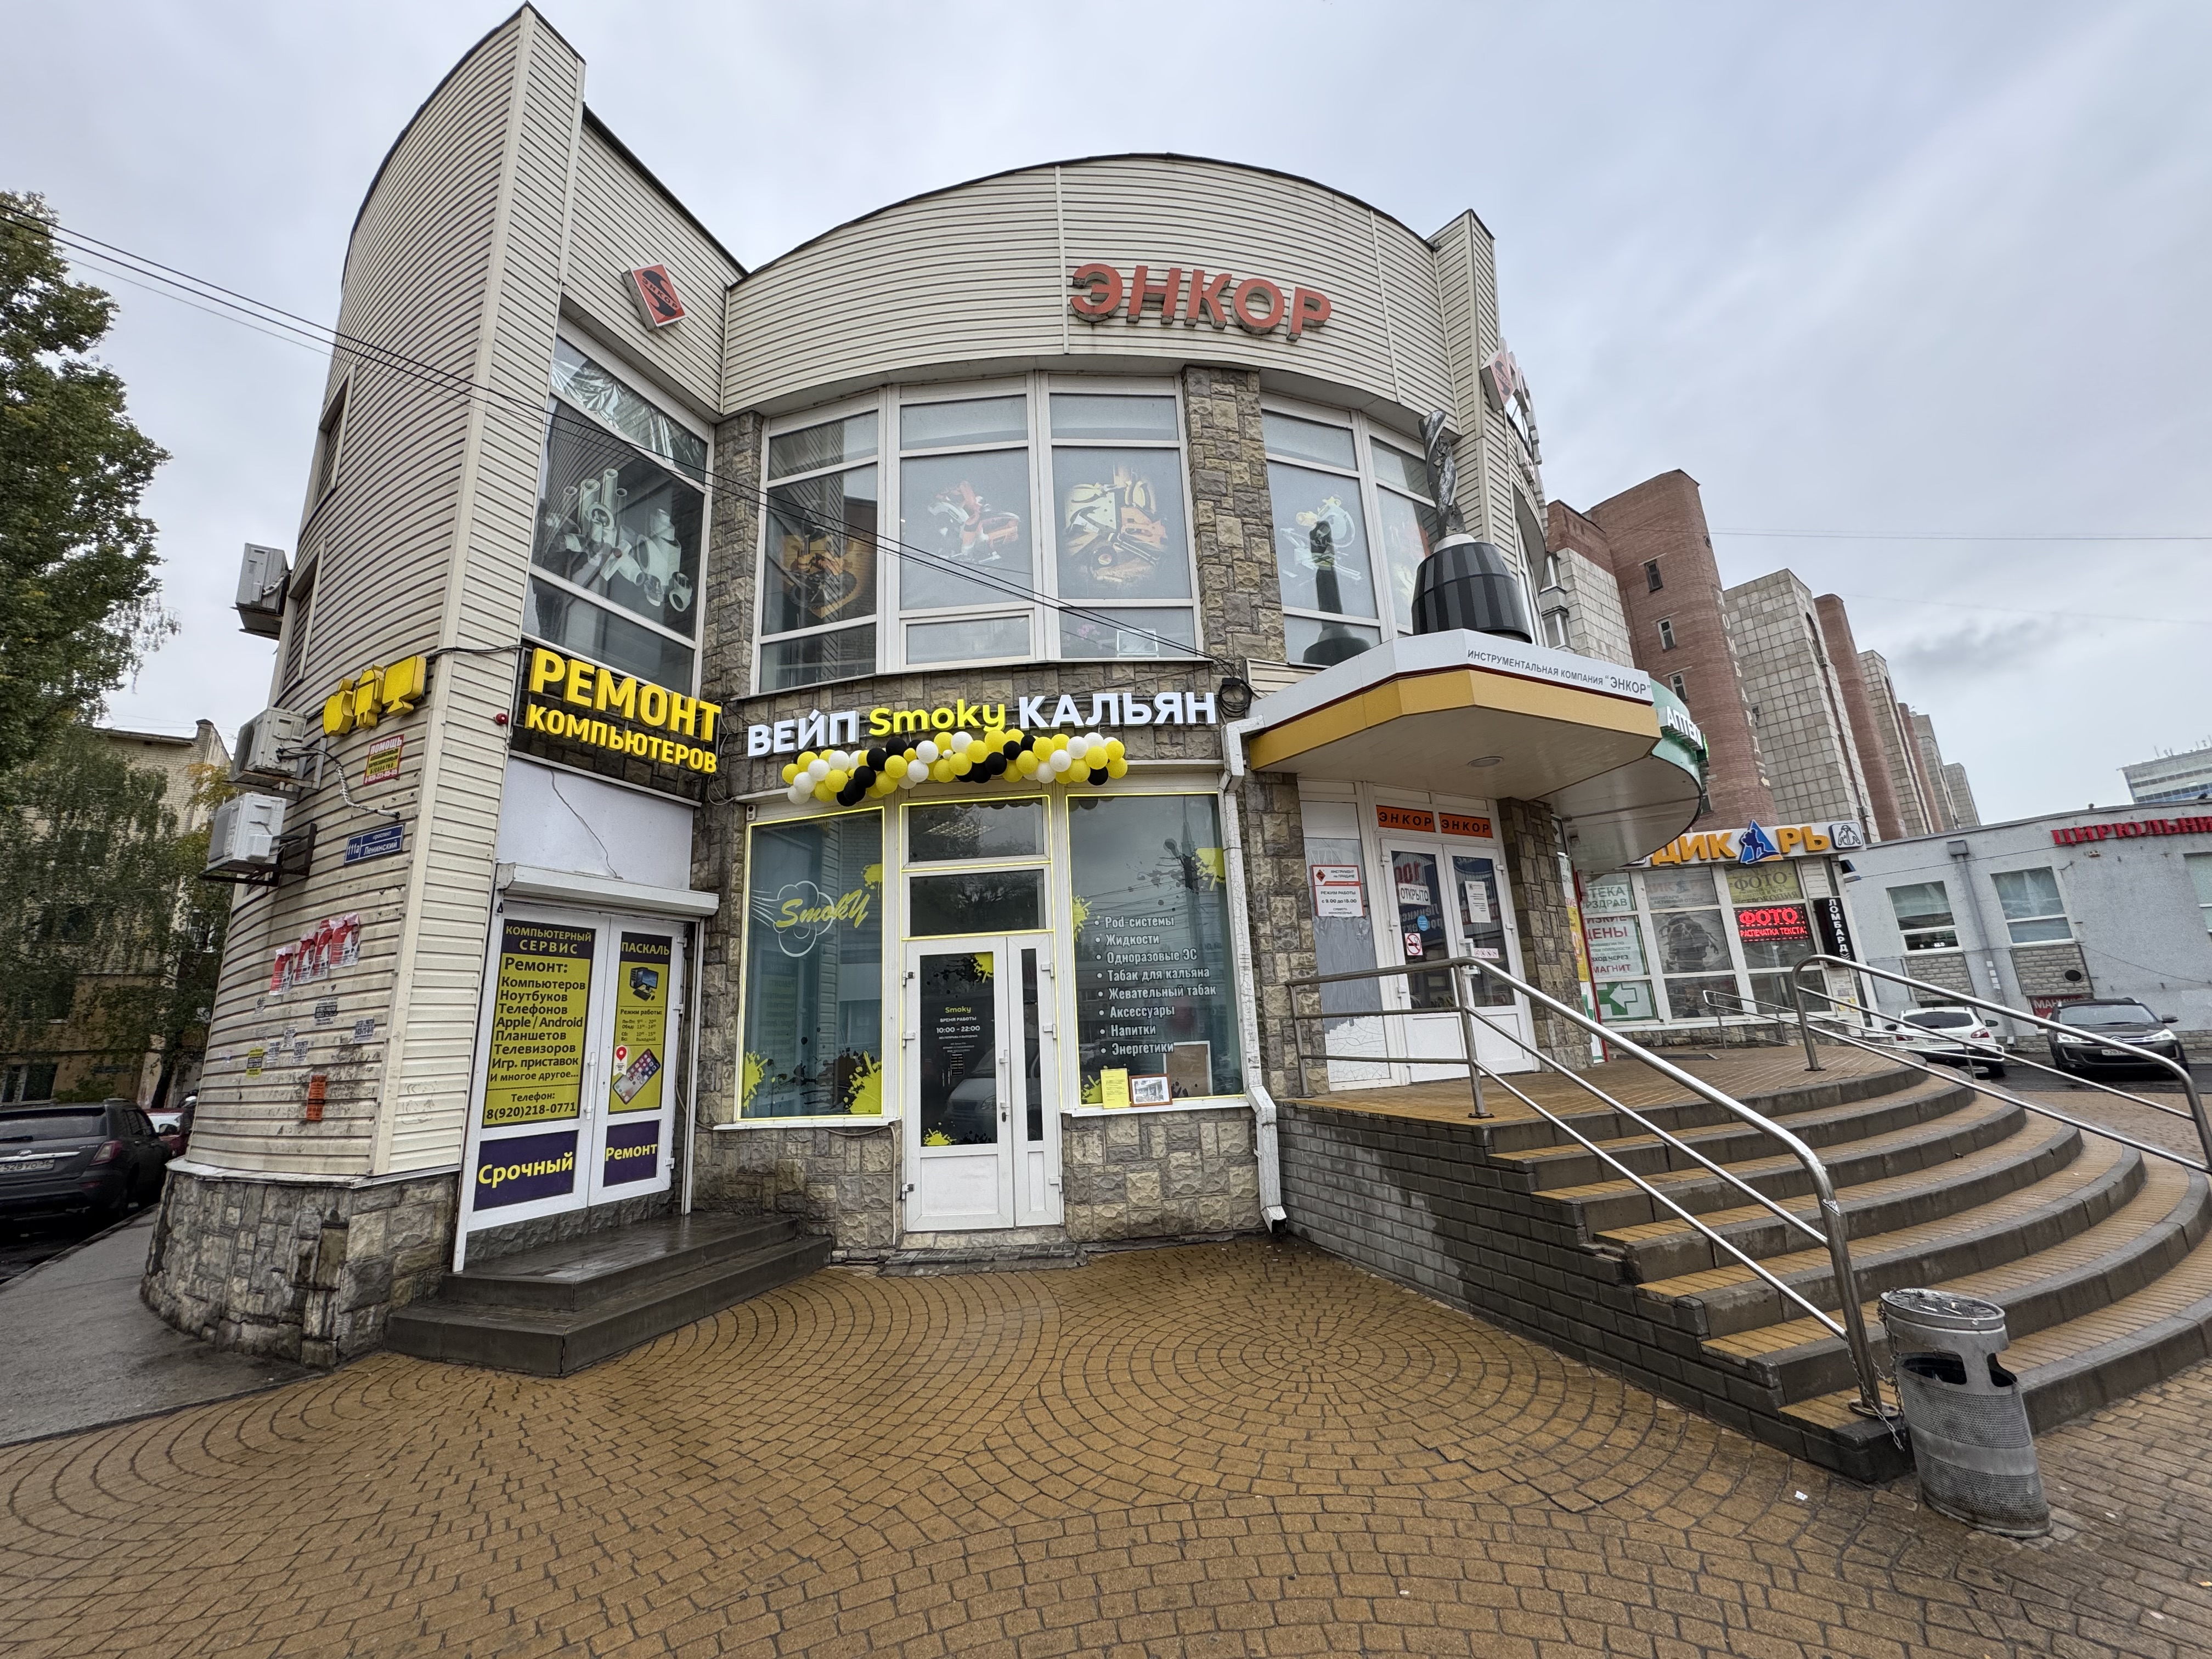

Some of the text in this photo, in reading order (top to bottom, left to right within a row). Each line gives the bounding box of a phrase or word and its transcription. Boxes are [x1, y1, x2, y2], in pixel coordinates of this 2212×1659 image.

[642, 278, 678, 308] ЭНКОР
[1070, 263, 1332, 341] ЭНКОР
[1468, 649, 1559, 676] ИНСТРУМЕНТАЛЬНАЯ
[1561, 669, 1603, 685] КОМПАНИЯ
[528, 647, 722, 742] РЕМОНТ
[868, 699, 1006, 738] Smoky
[1018, 692, 1217, 730] КАЛЬЯН
[524, 704, 718, 774] КОМПЬЮТЕРОВ
[747, 709, 859, 758] ВЕЙП
[370, 737, 402, 754] ПОМОЩЬ
[1379, 811, 1431, 827] ЭНКОР
[1441, 819, 1489, 833] ЭНКОР
[364, 839, 397, 855] Ленинский
[1734, 872, 1787, 890] ФОТО
[1400, 887, 1429, 901] ОТКРЫТО
[1589, 886, 1626, 898] ТЕКА
[1105, 916, 1175, 928] Pod-системы
[1739, 907, 1798, 926] ФОТО
[1740, 927, 1805, 937] РАСПЕЧАТКА ТЕКСТА
[1829, 899, 1849, 952] ЛОМБАРД
[505, 926, 591, 943] КОМПЬЮТЕРНЫЙ
[1105, 935, 1159, 947] Жидкости
[519, 939, 578, 955] СЕРВИС
[621, 941, 670, 956] ПАСКАЛЬ
[1107, 949, 1197, 964] Одноразовые ЭС
[504, 957, 568, 974] Ремонт:
[1594, 964, 1631, 973] МАГНИТ
[1108, 968, 1210, 981] Табак для кальяна
[501, 977, 586, 991] Компьютеров
[500, 989, 568, 1004] Ноутбуков
[1109, 984, 1216, 1000] Жевательный табак
[498, 1003, 568, 1017] Телефонов
[1110, 1006, 1175, 1019] Аксессуары
[496, 1017, 531, 1029] Apple
[539, 1016, 583, 1028] Android
[495, 1030, 567, 1041] Планшетов
[1111, 1025, 1156, 1037] Напитки
[494, 1043, 576, 1056] Телевизоров
[1112, 1043, 1174, 1057] Энергетики
[492, 1056, 579, 1071] Игр. приставок
[489, 1073, 498, 1082] И
[500, 1072, 537, 1082] многое
[511, 1091, 555, 1104] Телефон:
[486, 1102, 576, 1120] 8(920)218-0771
[605, 1143, 658, 1162] Ремонт
[478, 1152, 573, 1188] Срочный
